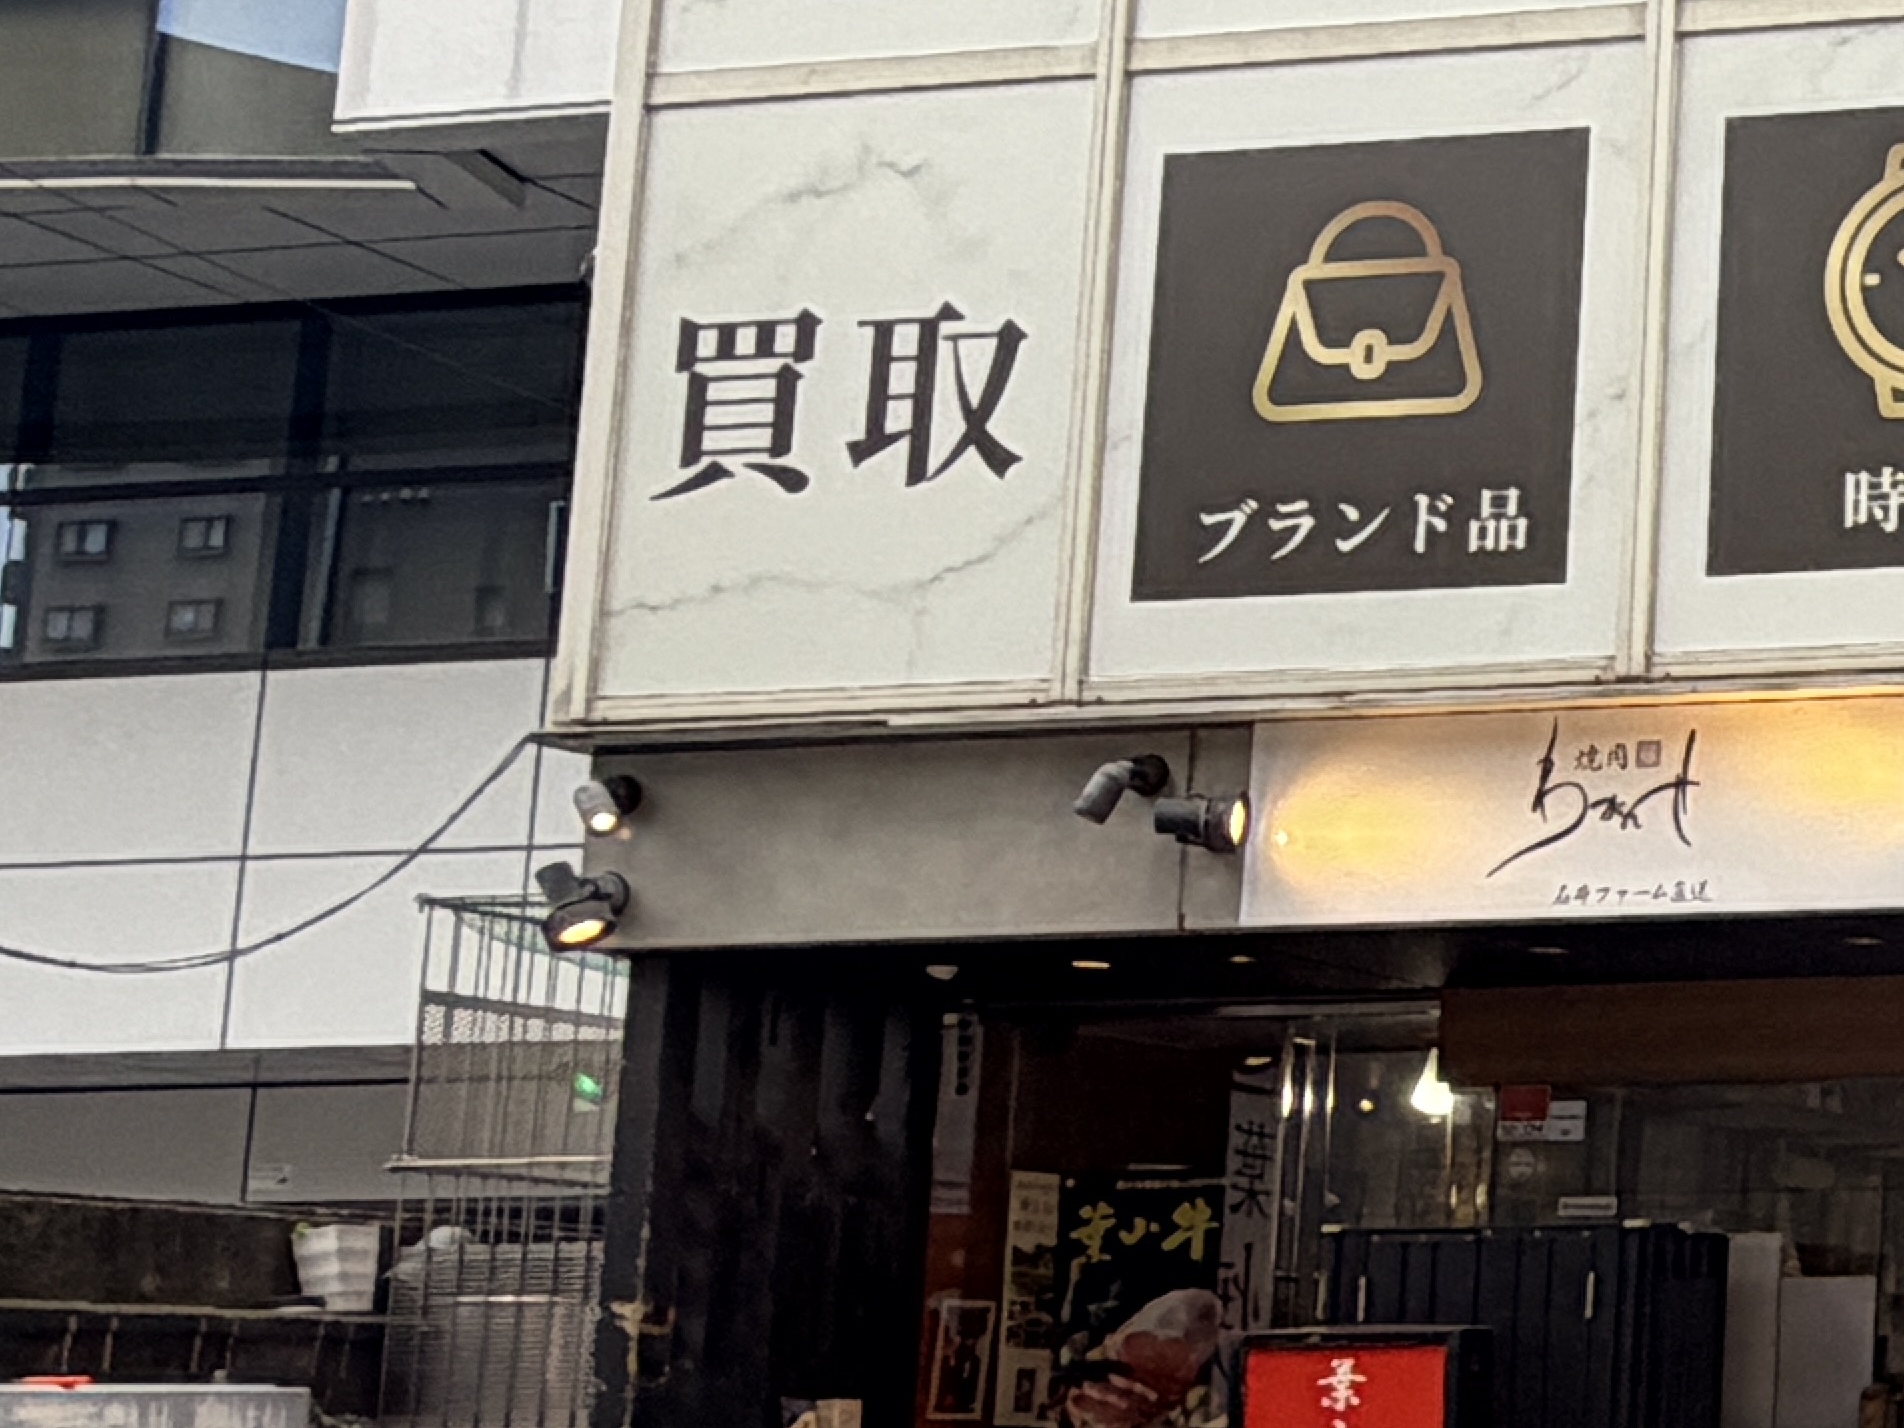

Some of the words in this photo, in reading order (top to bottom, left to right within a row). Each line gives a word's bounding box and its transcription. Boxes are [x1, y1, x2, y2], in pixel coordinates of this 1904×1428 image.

[649, 302, 1026, 502] 買取
[1195, 487, 1532, 566] ブランド品
